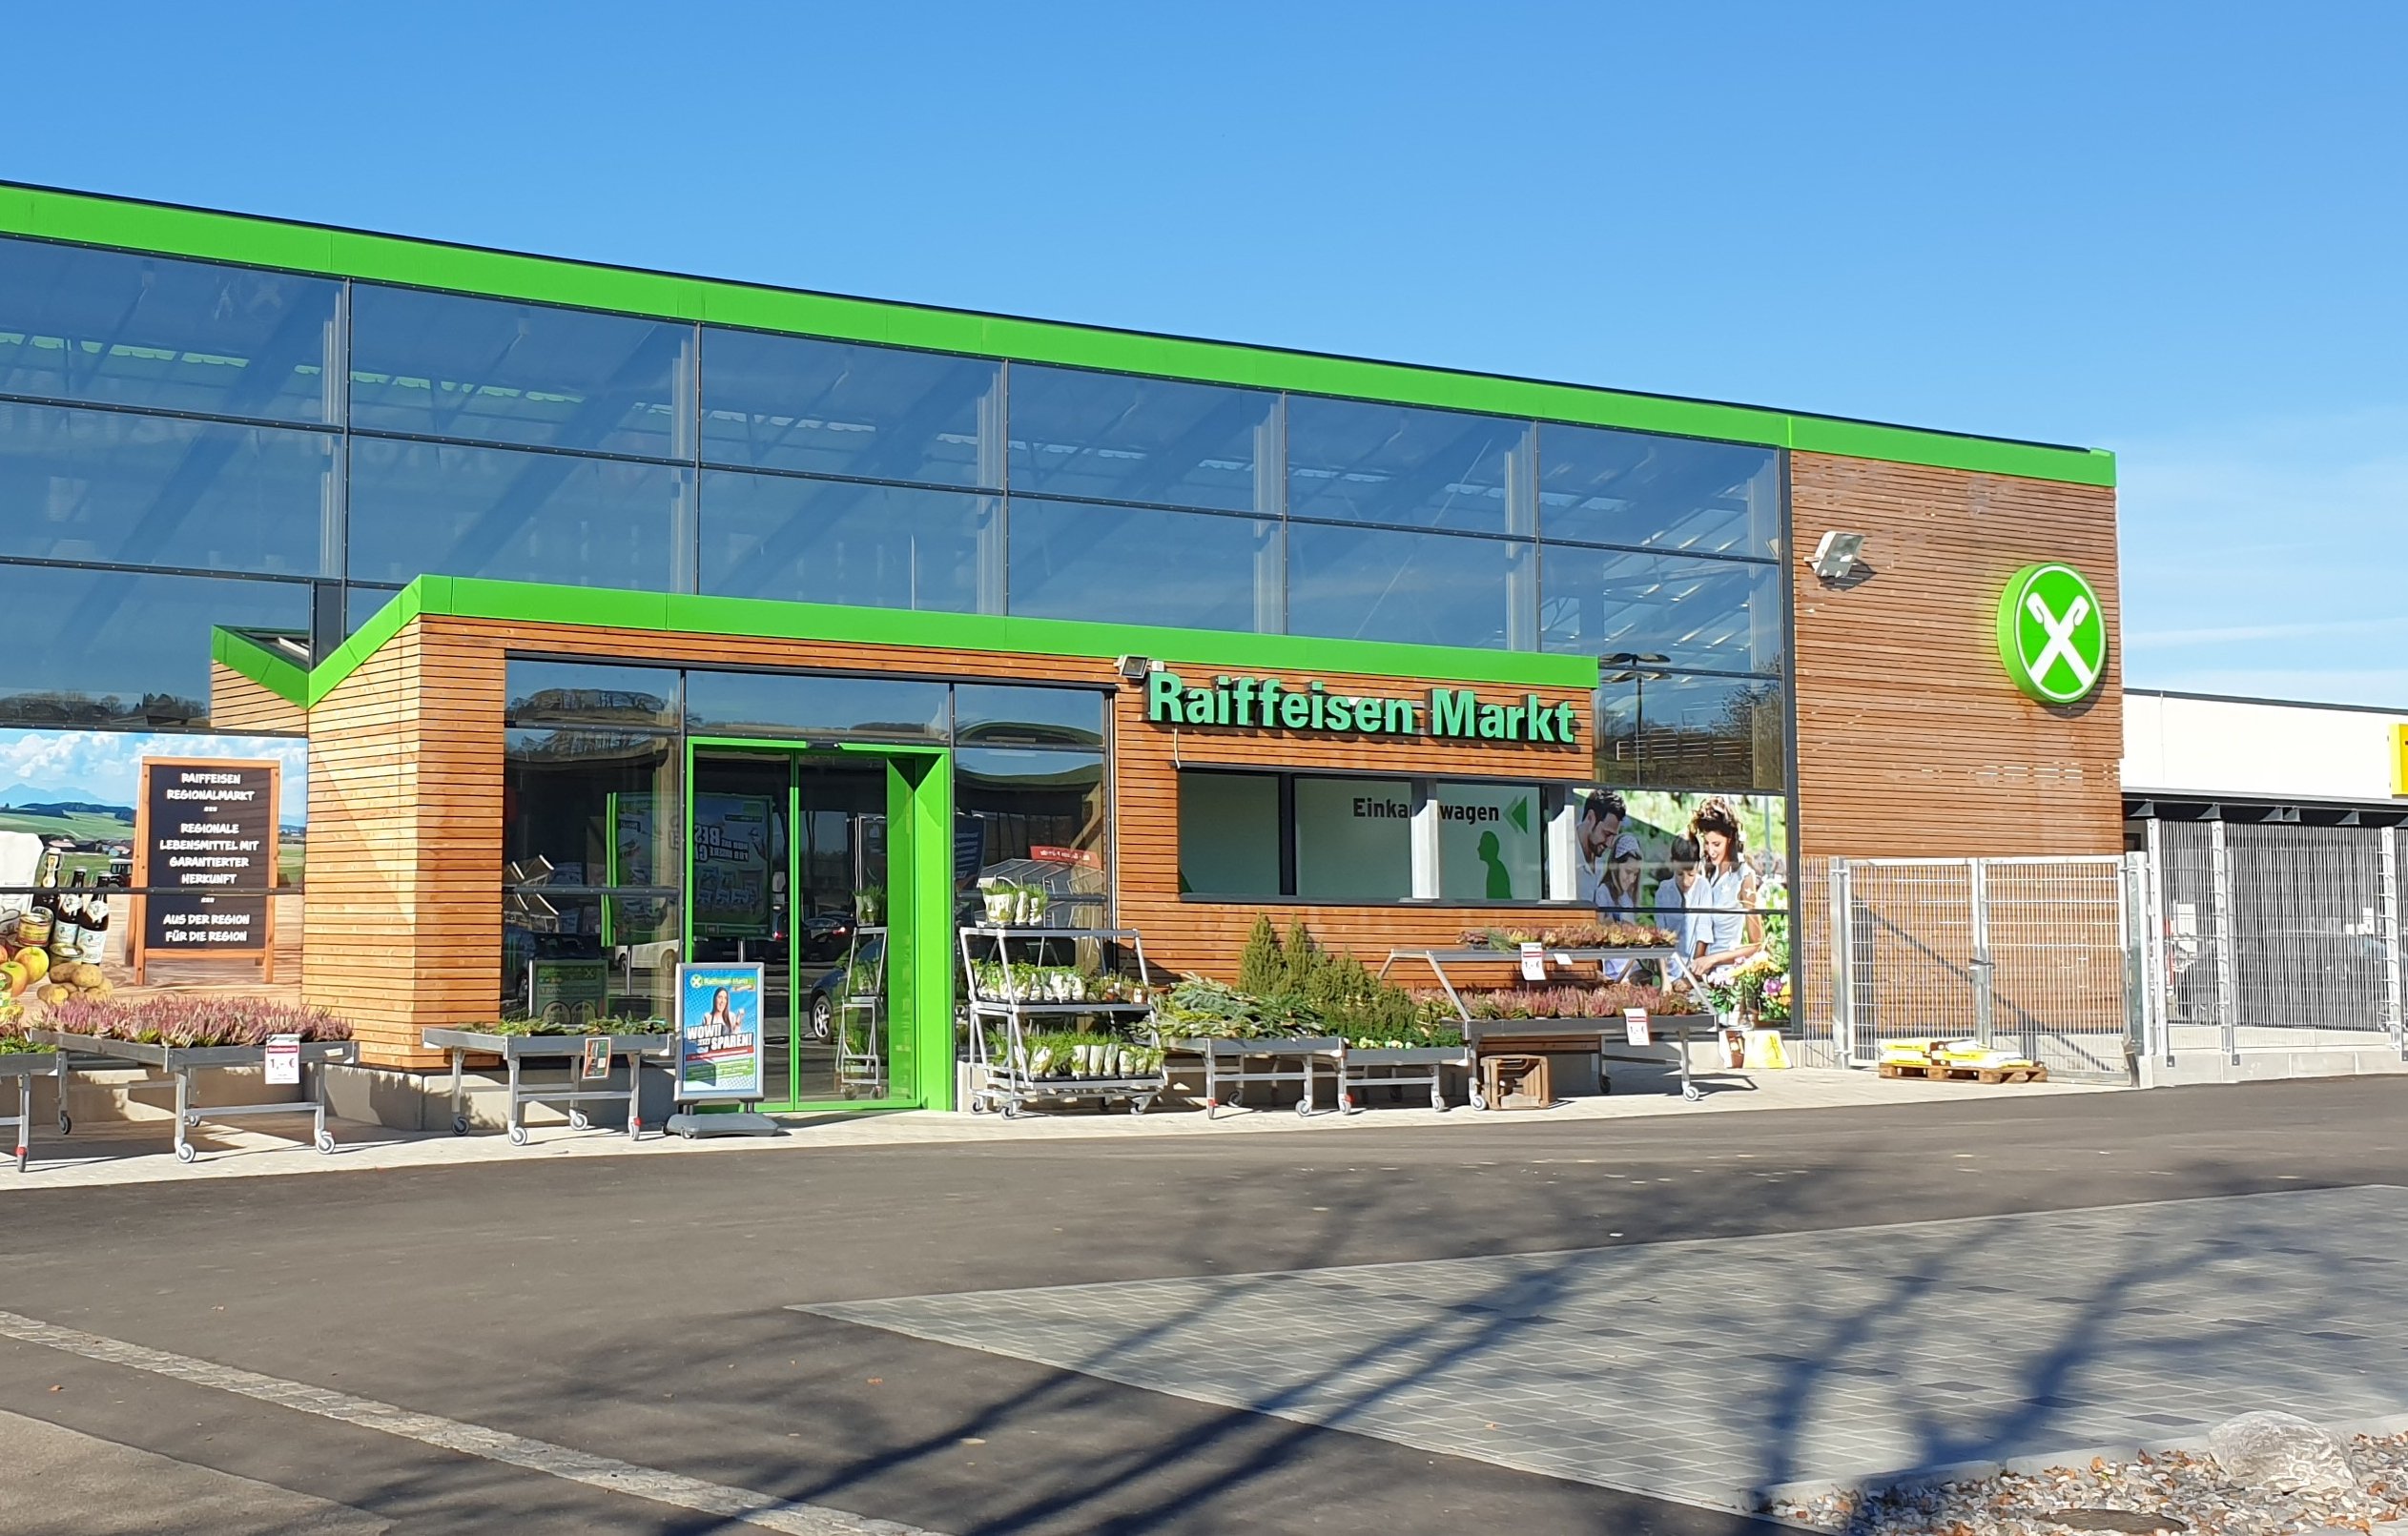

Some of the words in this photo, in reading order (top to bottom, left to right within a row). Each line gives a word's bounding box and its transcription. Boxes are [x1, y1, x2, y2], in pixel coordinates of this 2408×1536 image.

[1148, 670, 1415, 734] Raiffeisen
[1431, 687, 1575, 744] Markt
[181, 772, 241, 785] RAIFFEISEN
[166, 789, 256, 802] REGIONALMARKT
[1352, 797, 1500, 826] Einkawagen
[180, 823, 239, 834] REGIONALE
[159, 839, 238, 851] LEBENSMITTEL
[238, 840, 259, 851] MIT
[169, 856, 250, 868] GARANTIERTER
[181, 872, 237, 885] HERKUNFT
[163, 913, 186, 926] AUS
[188, 914, 211, 925] DER
[211, 913, 250, 925] REGION
[165, 930, 188, 943] FÜR
[189, 931, 208, 942] DIE
[208, 931, 248, 942] REGION
[710, 1033, 753, 1051] SPAREN!
